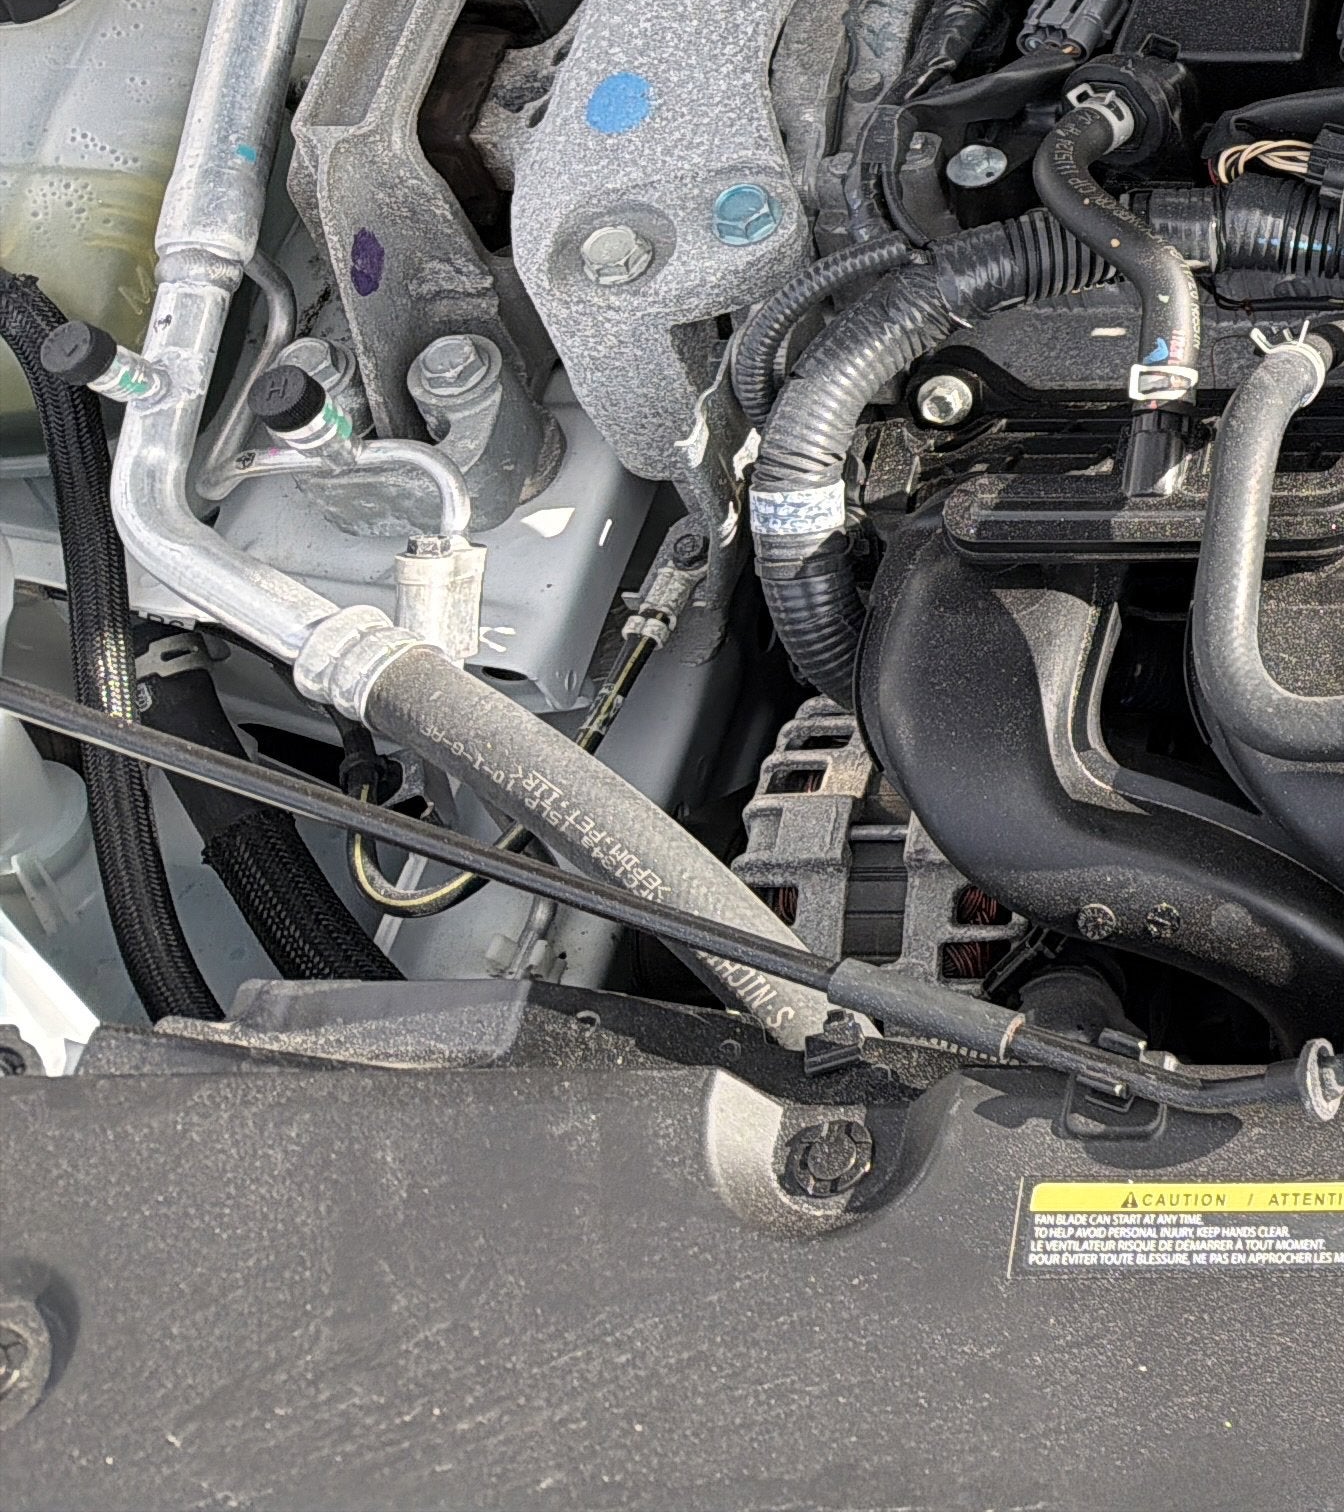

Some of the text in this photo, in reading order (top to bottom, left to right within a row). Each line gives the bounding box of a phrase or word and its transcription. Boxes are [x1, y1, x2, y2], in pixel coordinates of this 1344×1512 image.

[1142, 1193, 1226, 1207] CAUTION
[1034, 1214, 1055, 1225] FAN
[1055, 1214, 1088, 1225] BLADE
[1089, 1214, 1111, 1225] CAN
[1112, 1214, 1142, 1225] START
[1142, 1214, 1155, 1225] AT
[1156, 1214, 1178, 1225] ANY
[1034, 1226, 1048, 1238] TO
[1049, 1226, 1075, 1238] HELP
[1075, 1226, 1107, 1238] AVOID
[1108, 1226, 1158, 1238] PERSONAL
[1196, 1226, 1221, 1238] KEEP
[1221, 1226, 1257, 1238] HANDS
[1030, 1239, 1044, 1251] LE
[1045, 1239, 1116, 1251] VENTILATEUR
[1117, 1239, 1157, 1251] RISQUE
[1158, 1239, 1173, 1251] DE
[1245, 1239, 1275, 1251] TOUT
[1028, 1252, 1061, 1265] POUR
[1061, 1252, 1098, 1265] ÉVITER
[1099, 1252, 1135, 1265] TOUTE
[1193, 1252, 1207, 1265] NE
[1209, 1252, 1229, 1265] PAS
[1231, 1252, 1246, 1265] EN
[1247, 1252, 1312, 1265] APPROCHER
[1314, 1252, 1333, 1265] LES
